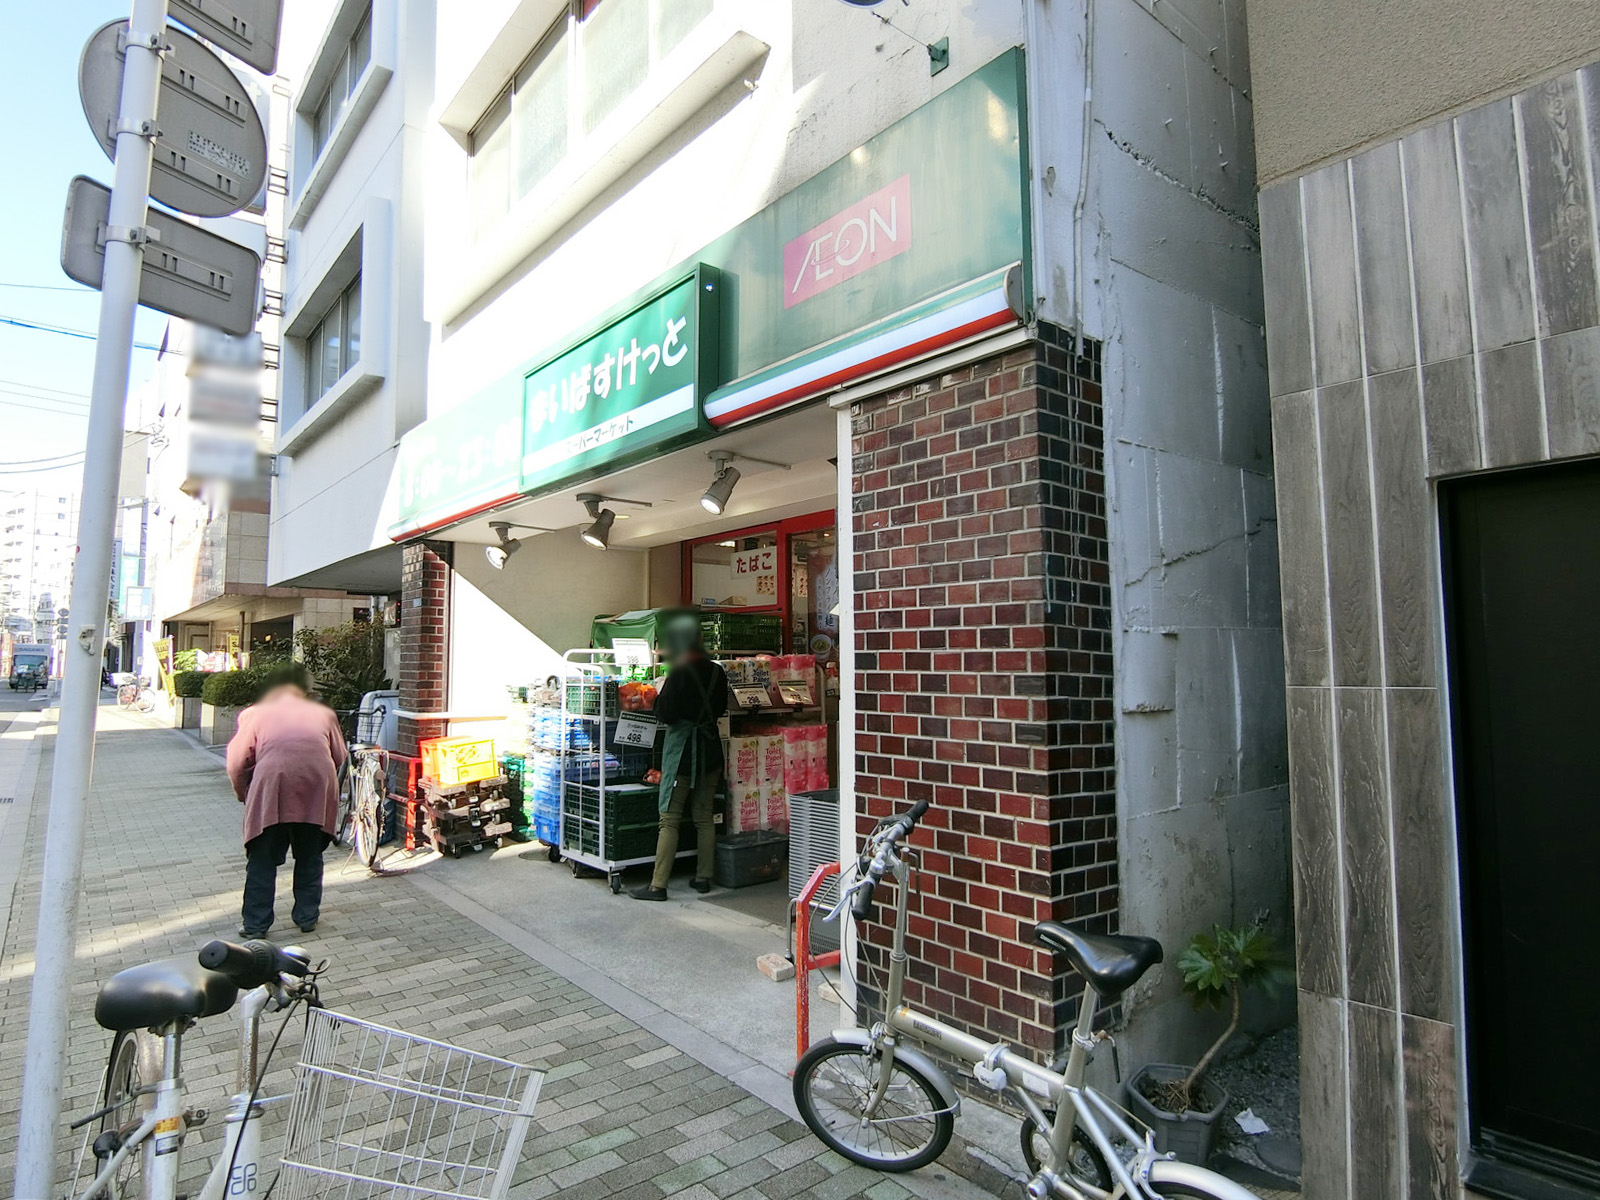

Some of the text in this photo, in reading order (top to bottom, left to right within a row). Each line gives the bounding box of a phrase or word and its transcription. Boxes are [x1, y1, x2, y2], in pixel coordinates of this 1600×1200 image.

[791, 196, 897, 294] AEON
[736, 552, 773, 574] たばこ
[626, 732, 642, 743] 498
[737, 749, 755, 757] Toilet
